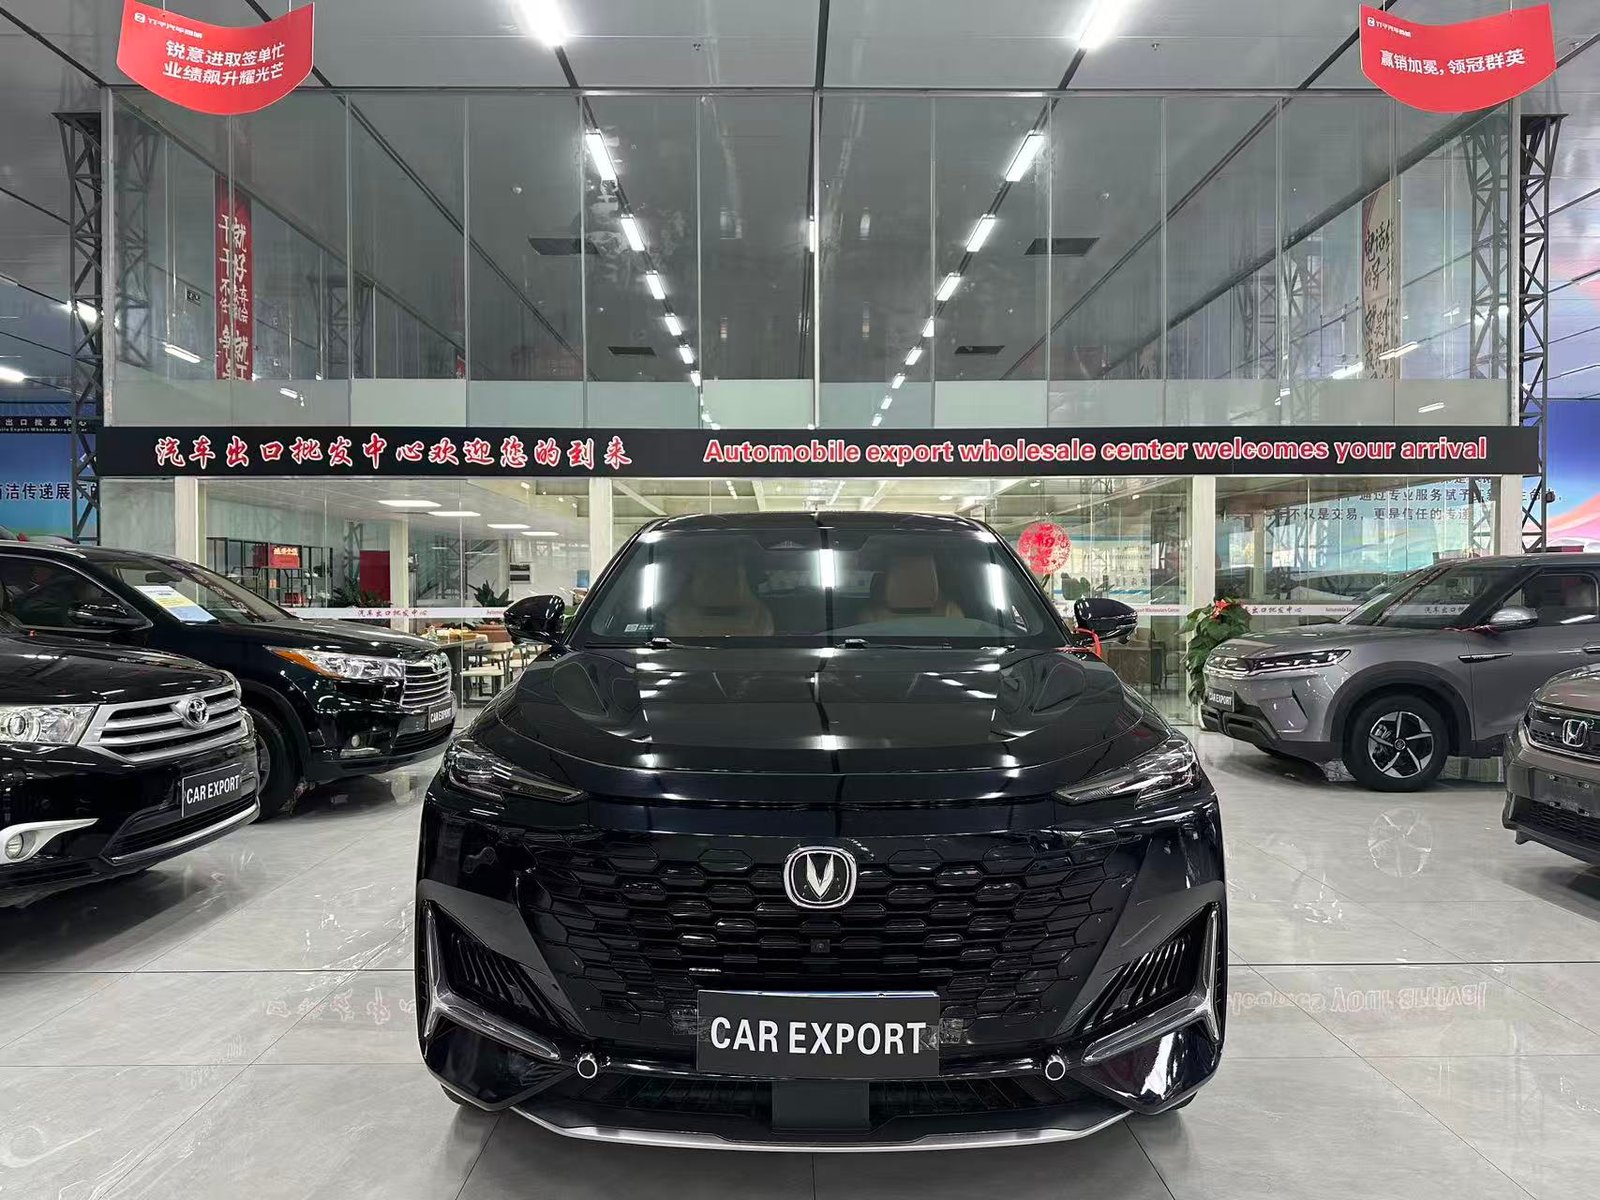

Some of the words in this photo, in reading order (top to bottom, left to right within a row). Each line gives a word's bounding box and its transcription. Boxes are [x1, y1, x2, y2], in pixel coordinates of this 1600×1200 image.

[165, 39, 286, 67] 锐意进取签单忙
[163, 61, 284, 87] 业绩飙升耀光芒
[155, 433, 632, 470] 汽车出口批发中心欢迎您的到来
[703, 439, 861, 463] Automobile
[865, 440, 954, 467] export
[958, 438, 1095, 462] wholesale
[1101, 439, 1188, 461] center
[1193, 437, 1329, 461] welcomes
[1336, 440, 1397, 464] your
[1400, 436, 1487, 460] arrival
[186, 785, 206, 805] CAR
[207, 774, 240, 799] EXPORT
[710, 1016, 779, 1053] CAR
[788, 1021, 927, 1055] EXPORT
